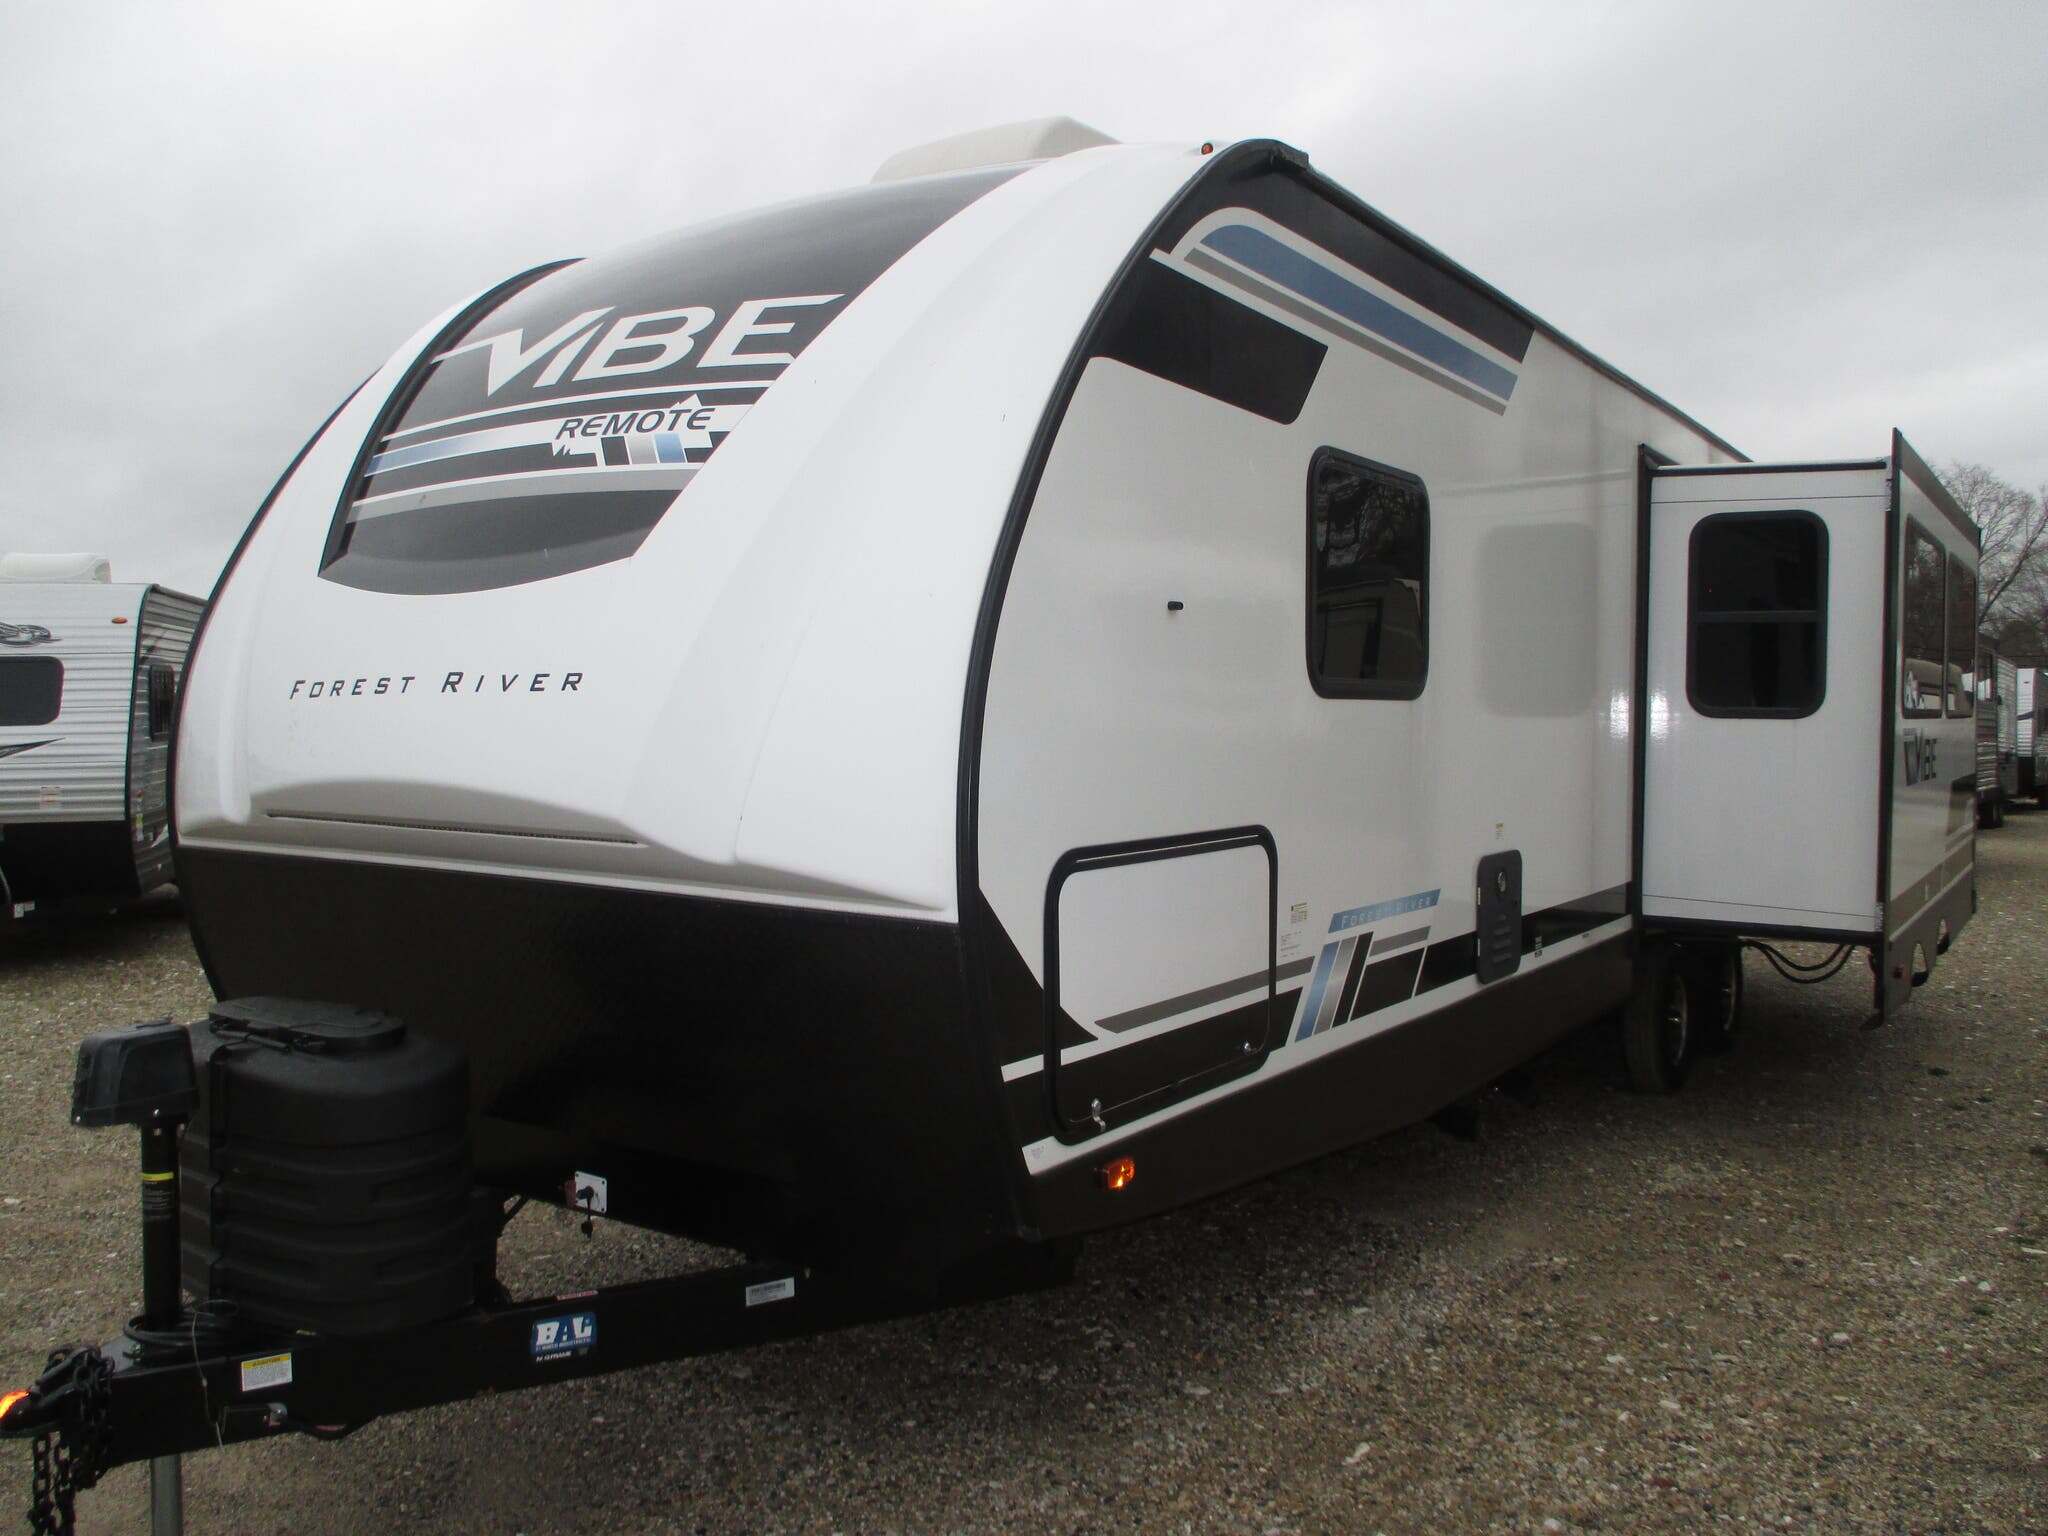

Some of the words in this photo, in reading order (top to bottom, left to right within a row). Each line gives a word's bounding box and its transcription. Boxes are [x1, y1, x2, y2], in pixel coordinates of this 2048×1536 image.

[431, 293, 848, 398] VIBE
[555, 406, 717, 441] REMOTE
[289, 675, 416, 700] FOREST
[440, 671, 584, 694] RIVER
[535, 1316, 593, 1346] BAL
